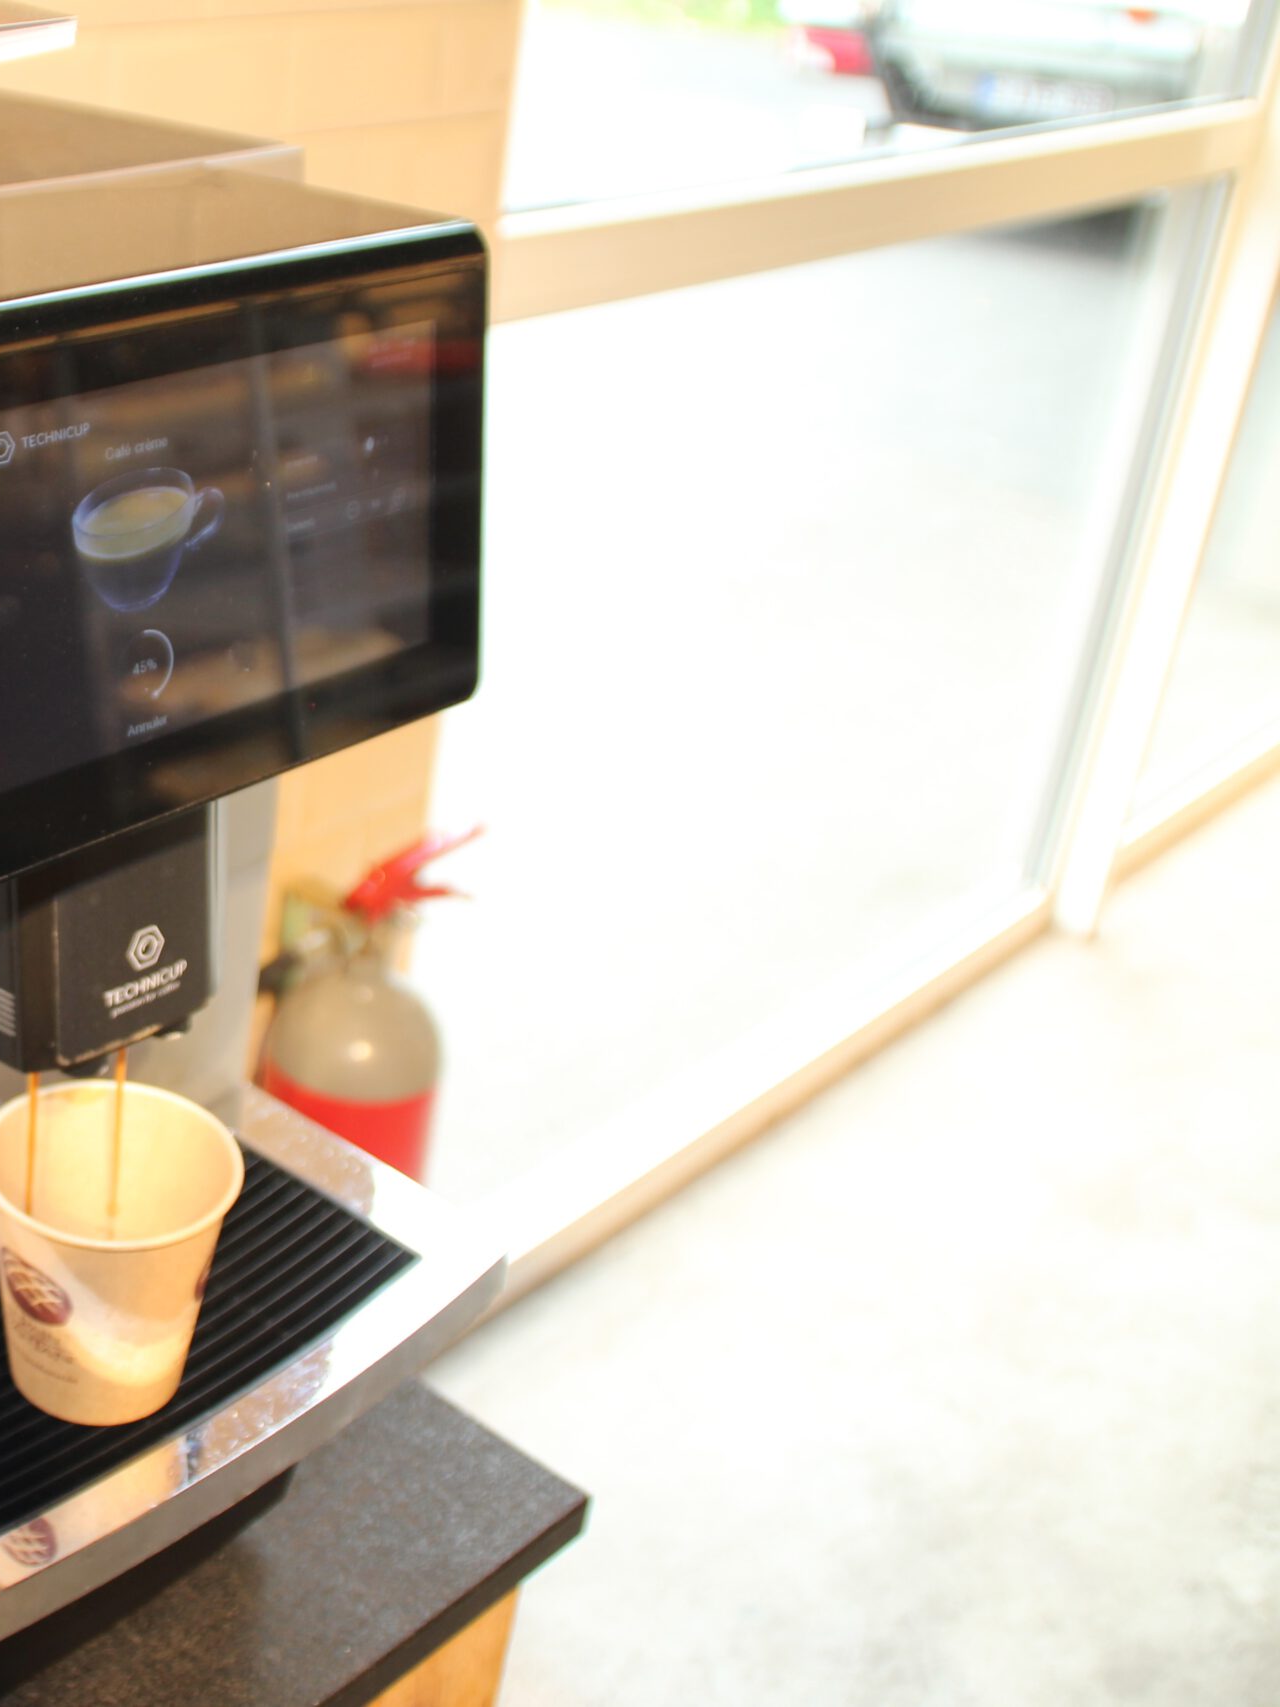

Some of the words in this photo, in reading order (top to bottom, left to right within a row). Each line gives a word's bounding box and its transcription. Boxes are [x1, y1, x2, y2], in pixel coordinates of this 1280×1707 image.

[20, 421, 91, 449] TECHNICUP
[132, 658, 158, 675] 45%
[103, 959, 188, 1008] TECHNICUP
